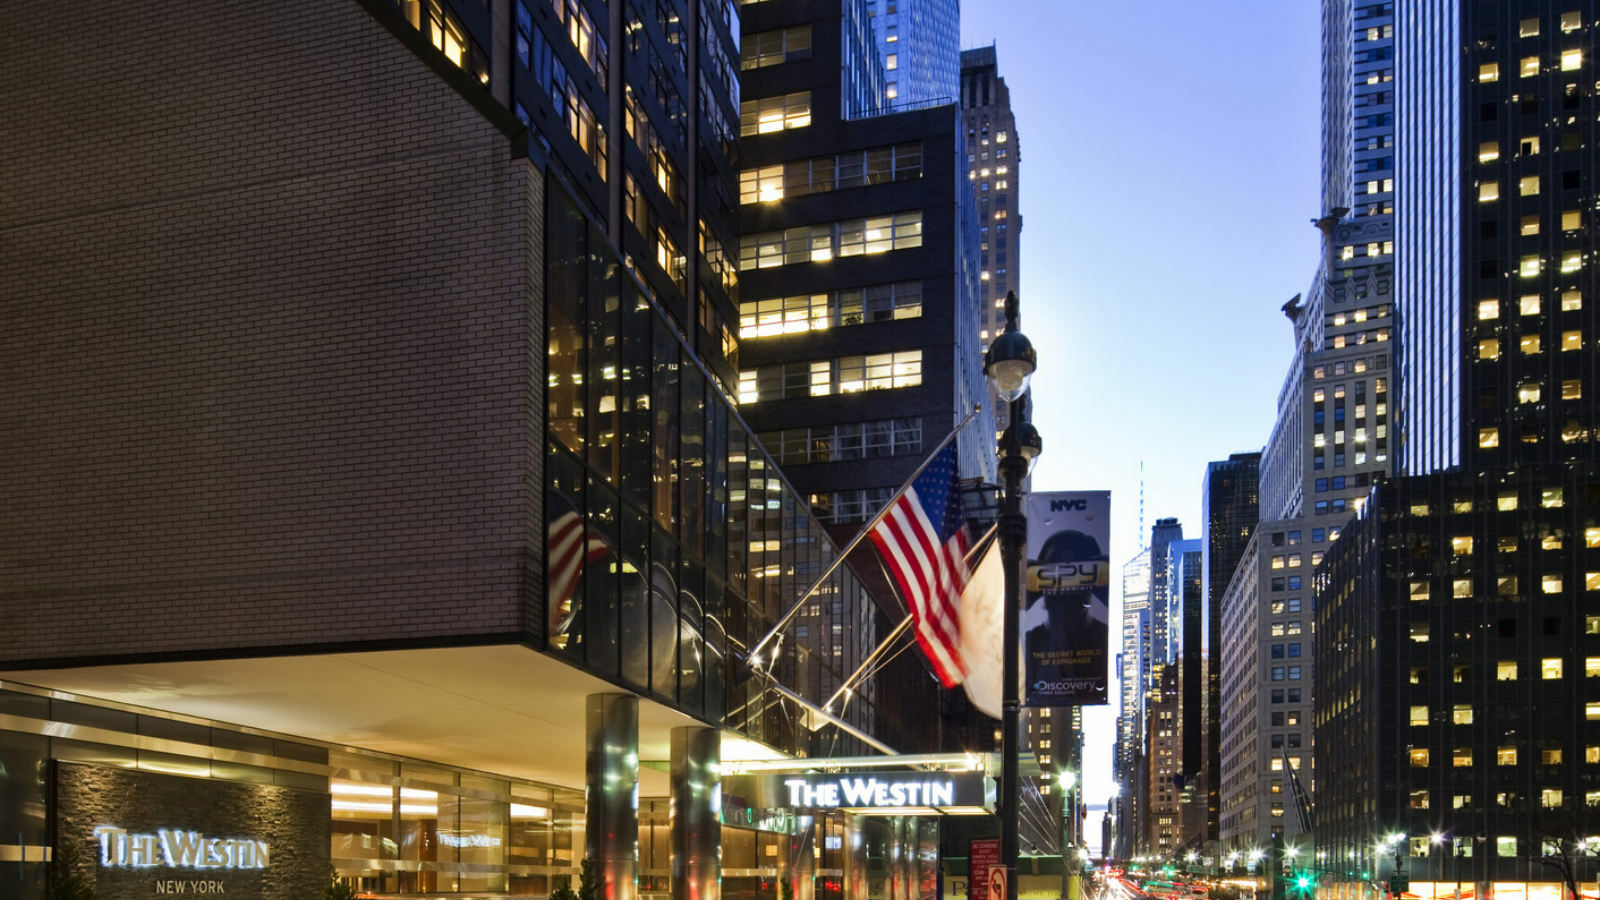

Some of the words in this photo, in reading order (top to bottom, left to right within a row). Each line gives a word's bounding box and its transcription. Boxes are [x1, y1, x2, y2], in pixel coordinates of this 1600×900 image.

[1050, 499, 1088, 512] NYC
[1037, 563, 1098, 588] SPY
[156, 880, 186, 894] NEW
[190, 880, 225, 894] YORK
